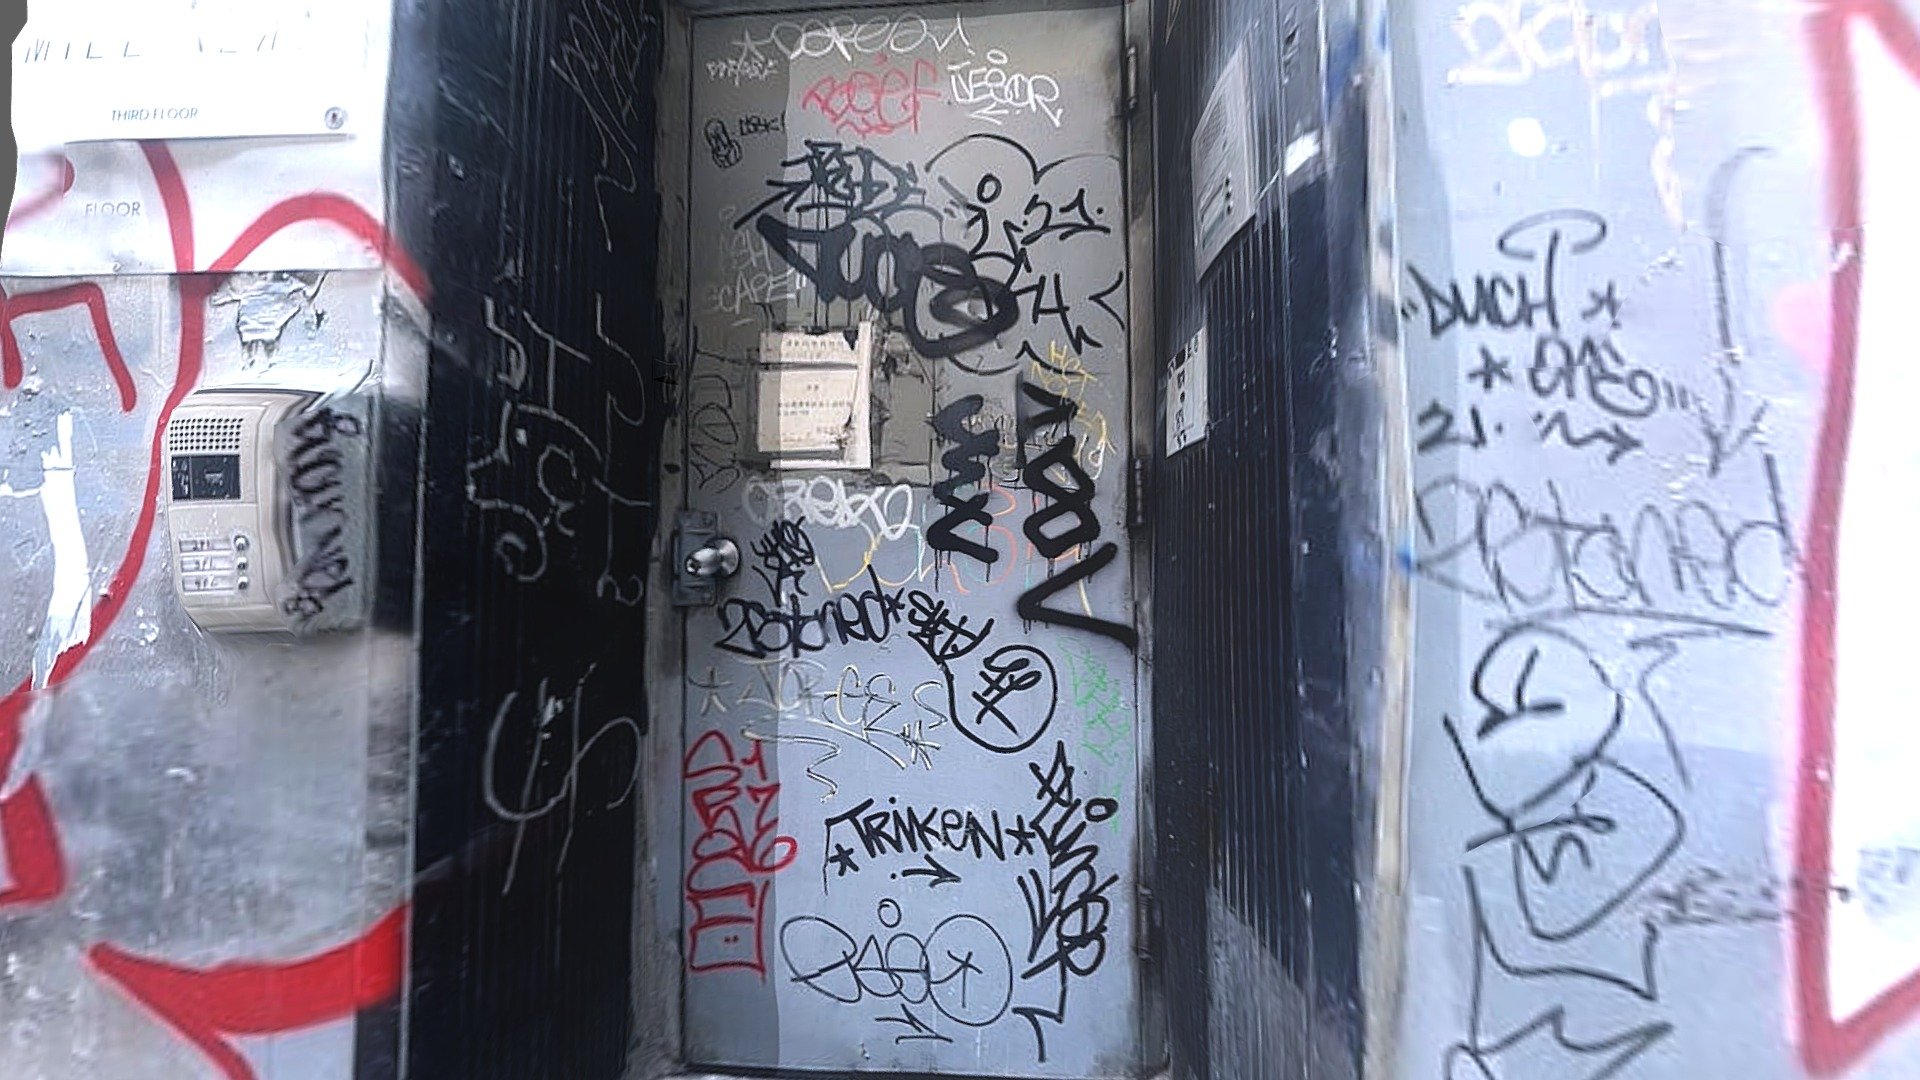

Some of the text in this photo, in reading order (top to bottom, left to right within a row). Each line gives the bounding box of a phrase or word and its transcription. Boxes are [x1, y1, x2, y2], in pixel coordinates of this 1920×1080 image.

[111, 106, 199, 121] THIRD FLOOR
[85, 201, 141, 216] FLOOR
